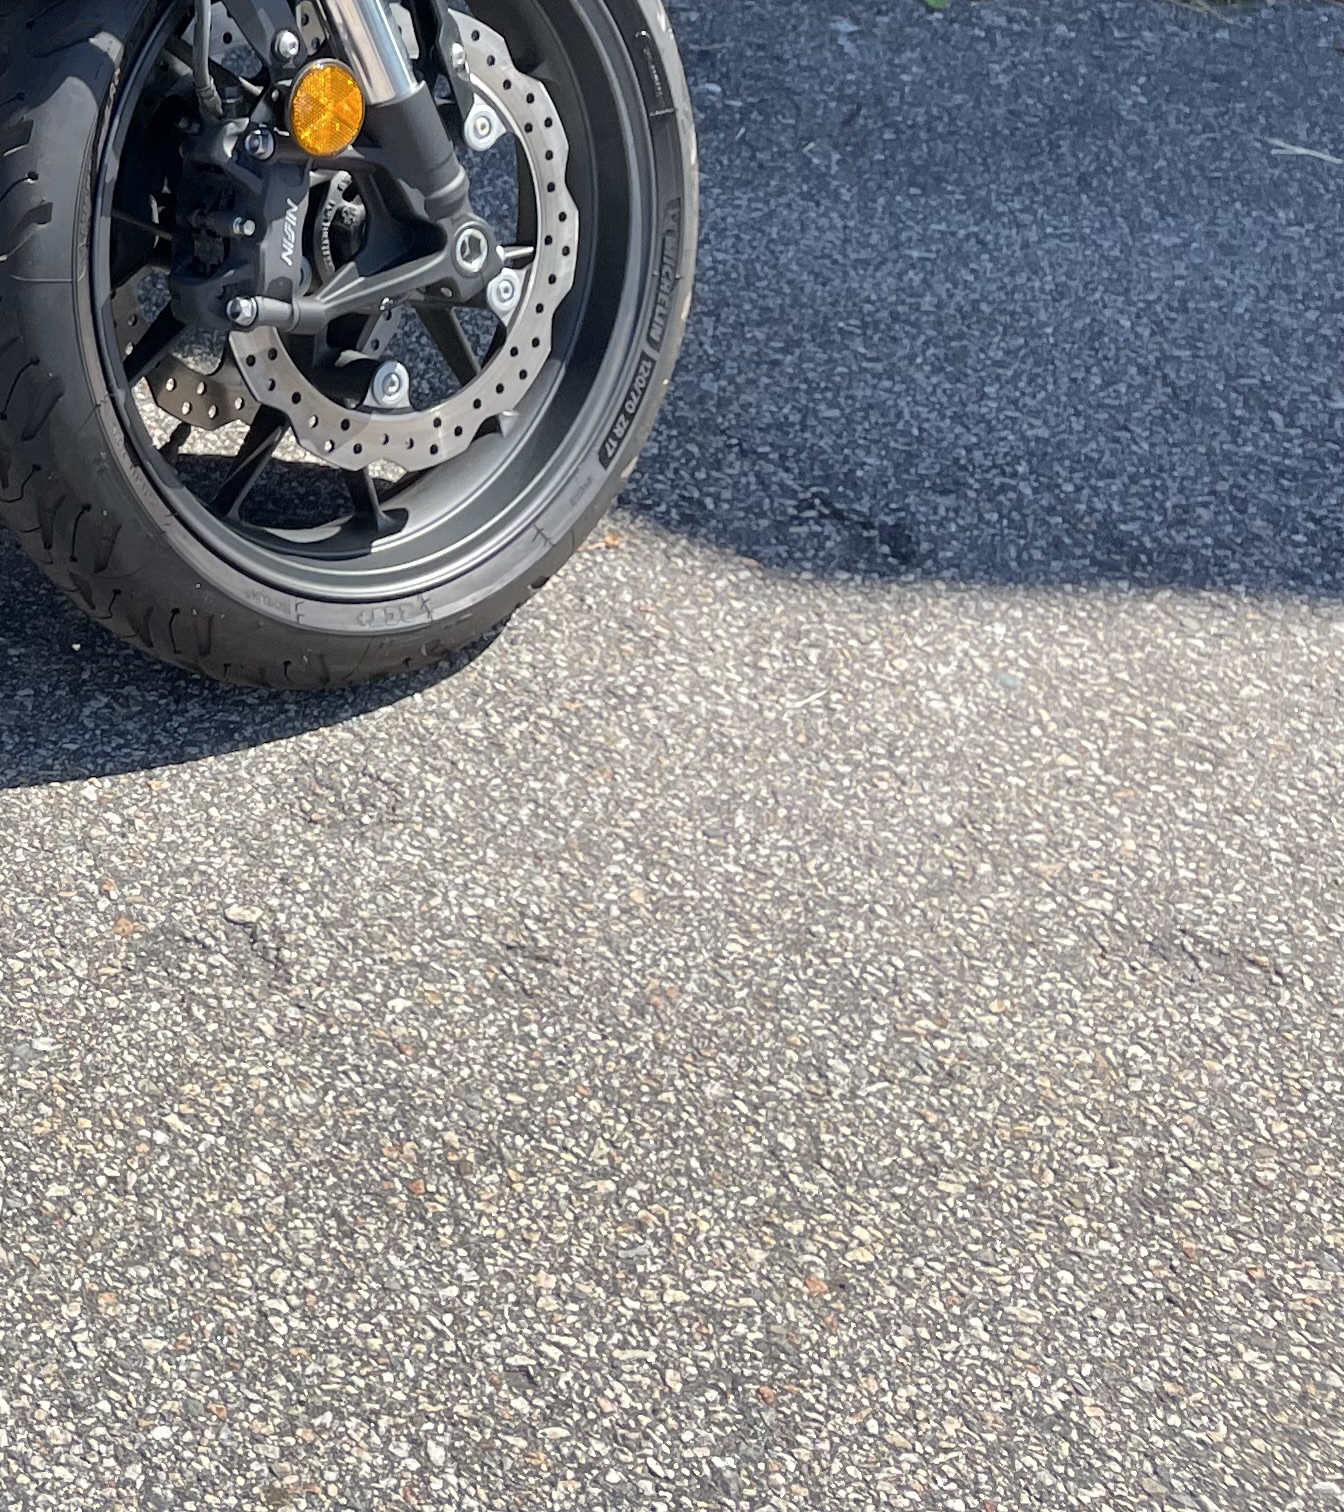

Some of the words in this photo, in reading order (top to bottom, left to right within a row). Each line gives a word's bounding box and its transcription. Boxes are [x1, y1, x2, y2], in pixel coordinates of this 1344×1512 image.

[649, 235, 678, 343] MICHELIN
[624, 360, 653, 414] 120/70
[612, 413, 630, 438] ZR
[604, 437, 618, 458] 17
